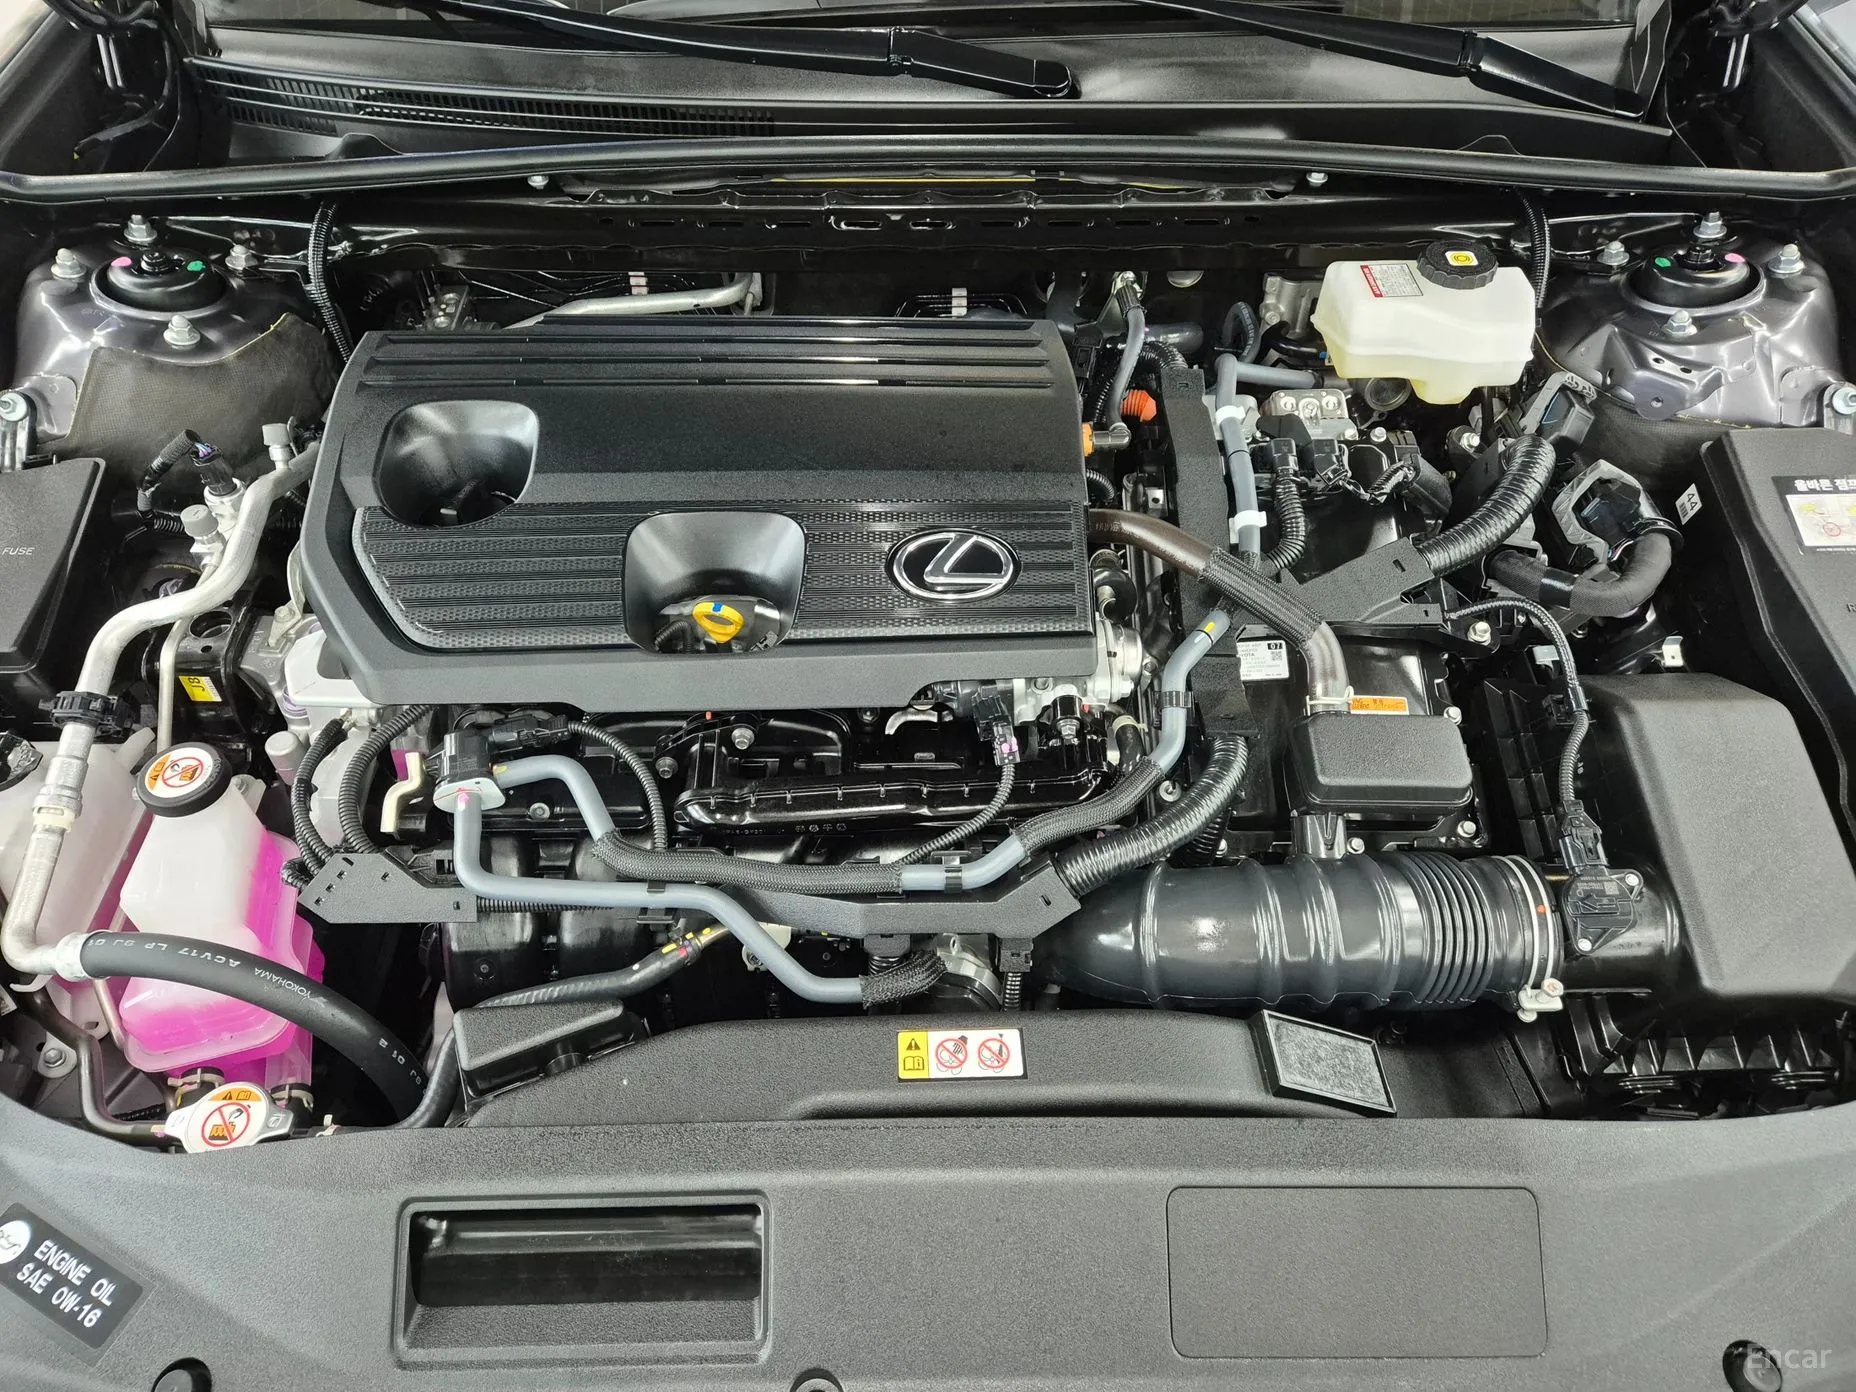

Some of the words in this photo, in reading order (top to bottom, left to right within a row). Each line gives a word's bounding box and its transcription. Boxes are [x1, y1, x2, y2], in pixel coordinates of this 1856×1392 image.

[1794, 479, 1834, 491] 올바른
[1687, 493, 1698, 512] 44
[2, 546, 35, 555] FUSE
[143, 942, 168, 951] LP
[177, 947, 241, 968] ACV17
[254, 967, 312, 1001] YOKOHAMA
[16, 1262, 54, 1295] SAE
[33, 1239, 92, 1286] ENGINE
[90, 1277, 118, 1307] OIL
